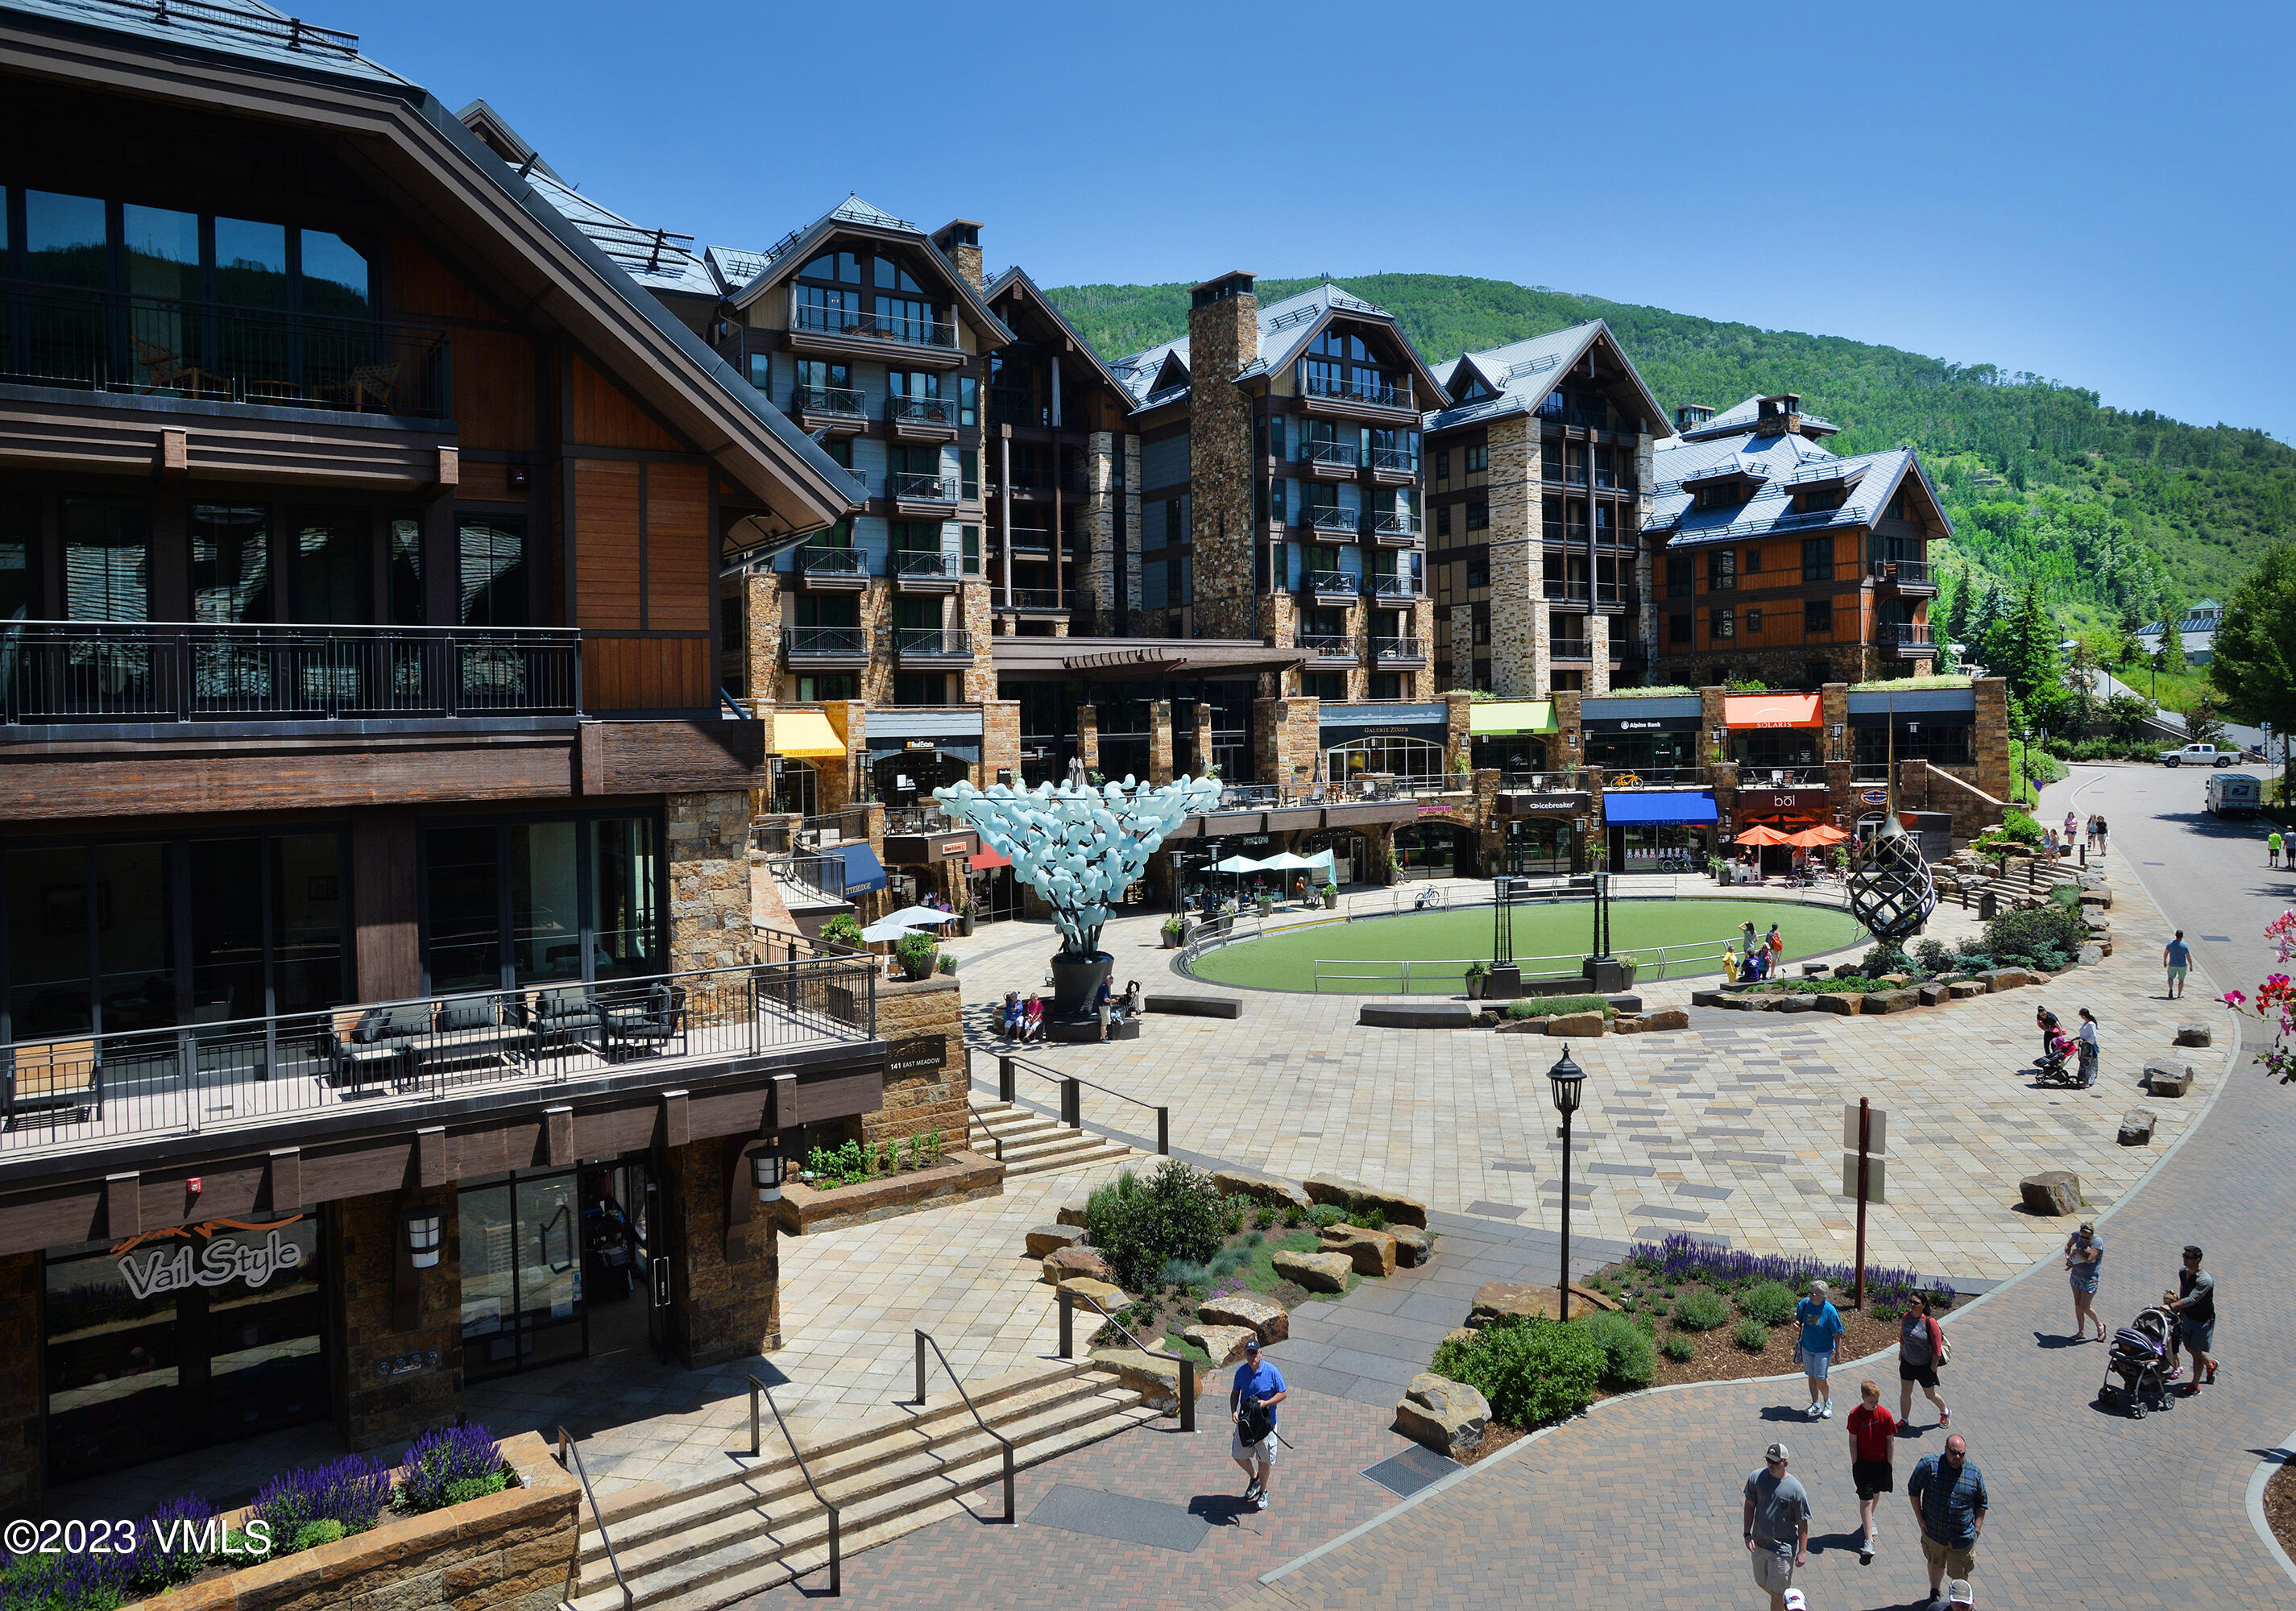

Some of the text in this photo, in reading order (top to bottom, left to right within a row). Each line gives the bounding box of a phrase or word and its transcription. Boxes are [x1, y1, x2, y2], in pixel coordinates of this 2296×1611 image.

[845, 882, 872, 895] TTERIDGE
[888, 1045, 927, 1058] SOLARIS
[890, 1058, 940, 1071] 141 EAST MEADOW
[119, 1231, 300, 1298] Vail Style
